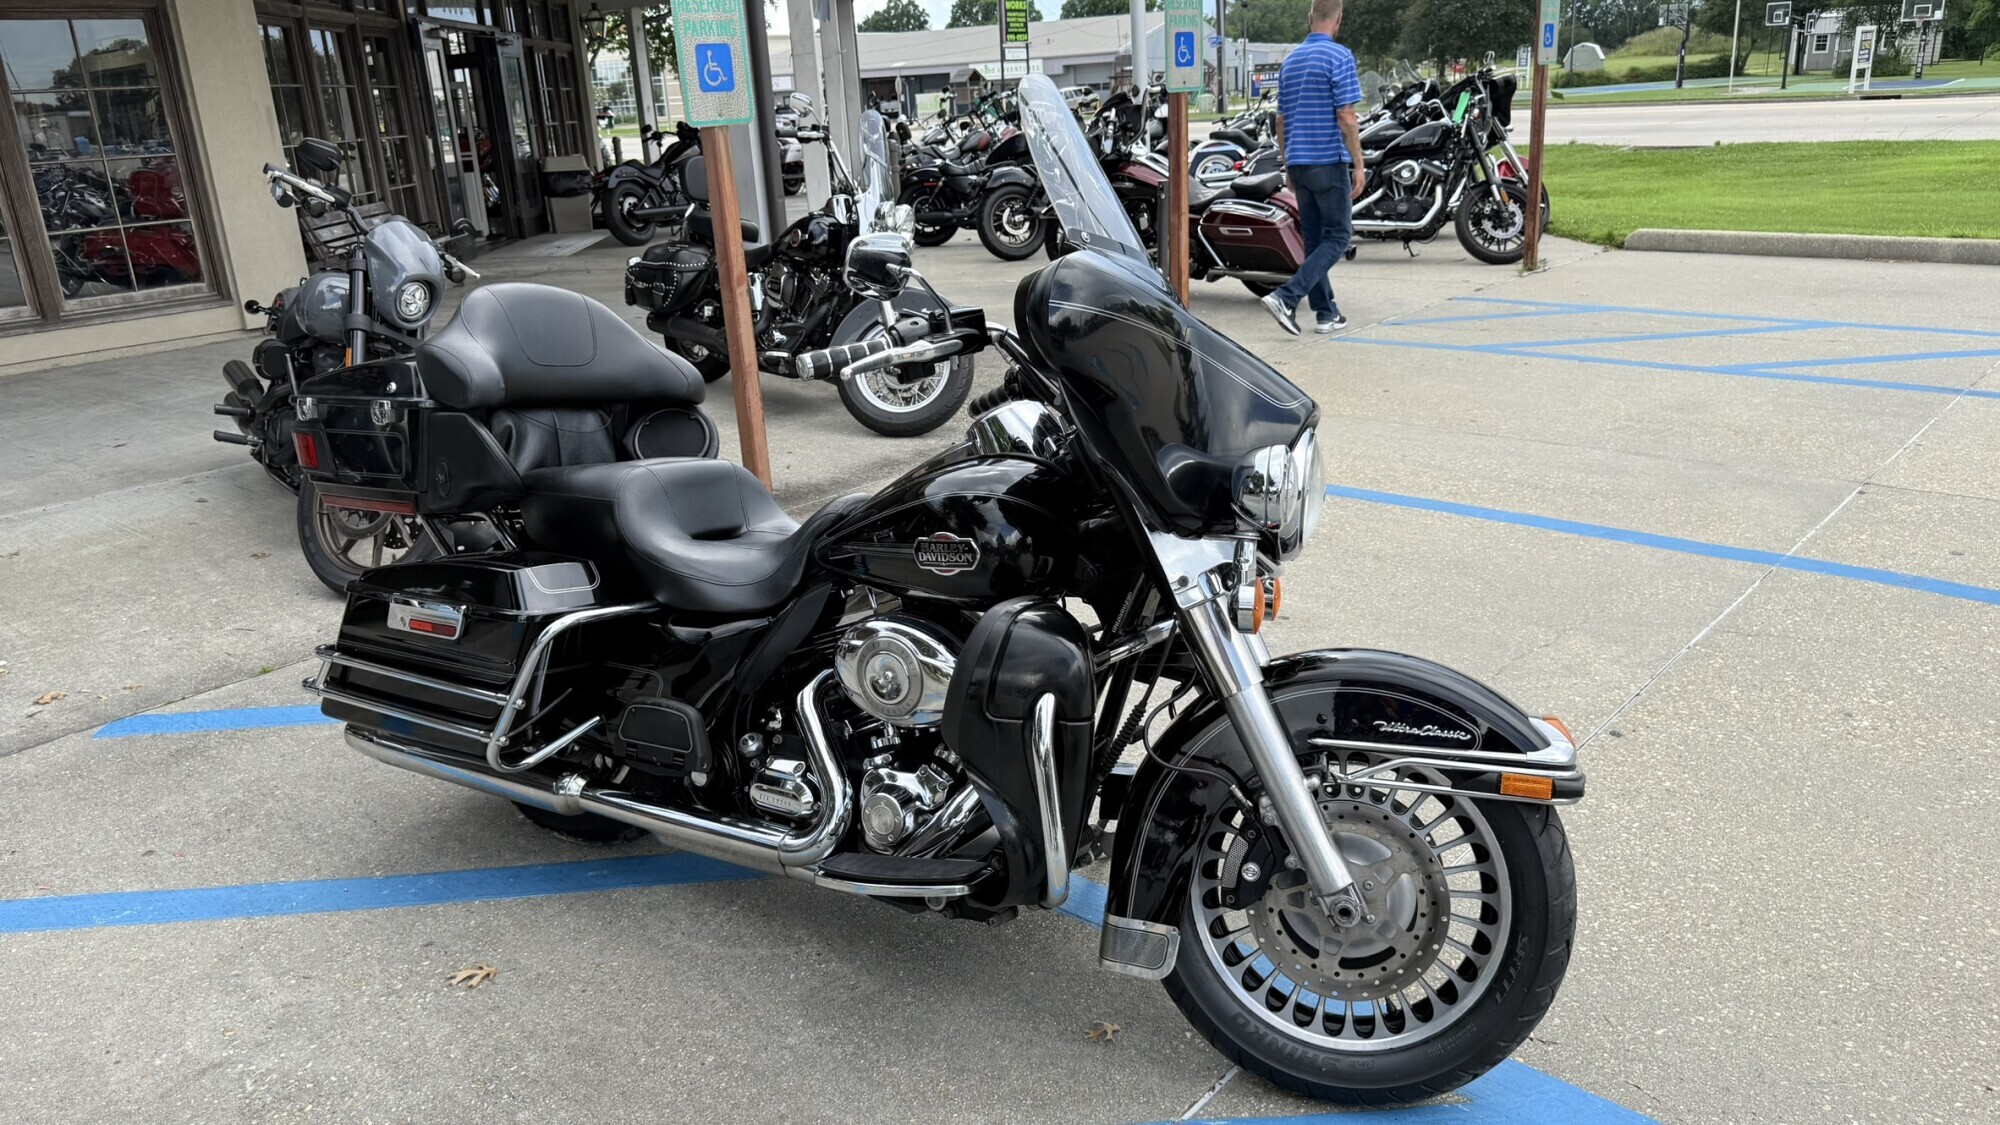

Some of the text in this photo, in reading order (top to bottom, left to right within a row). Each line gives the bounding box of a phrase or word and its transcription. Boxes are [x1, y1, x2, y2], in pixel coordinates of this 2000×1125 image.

[680, 0, 738, 13] RESERVED
[1170, 14, 1199, 27] PARKING
[683, 20, 738, 37] PARKING
[920, 542, 969, 553] HARLEY-
[918, 552, 973, 563] DAVIDSON
[1231, 1011, 1341, 1072] SHINKO
